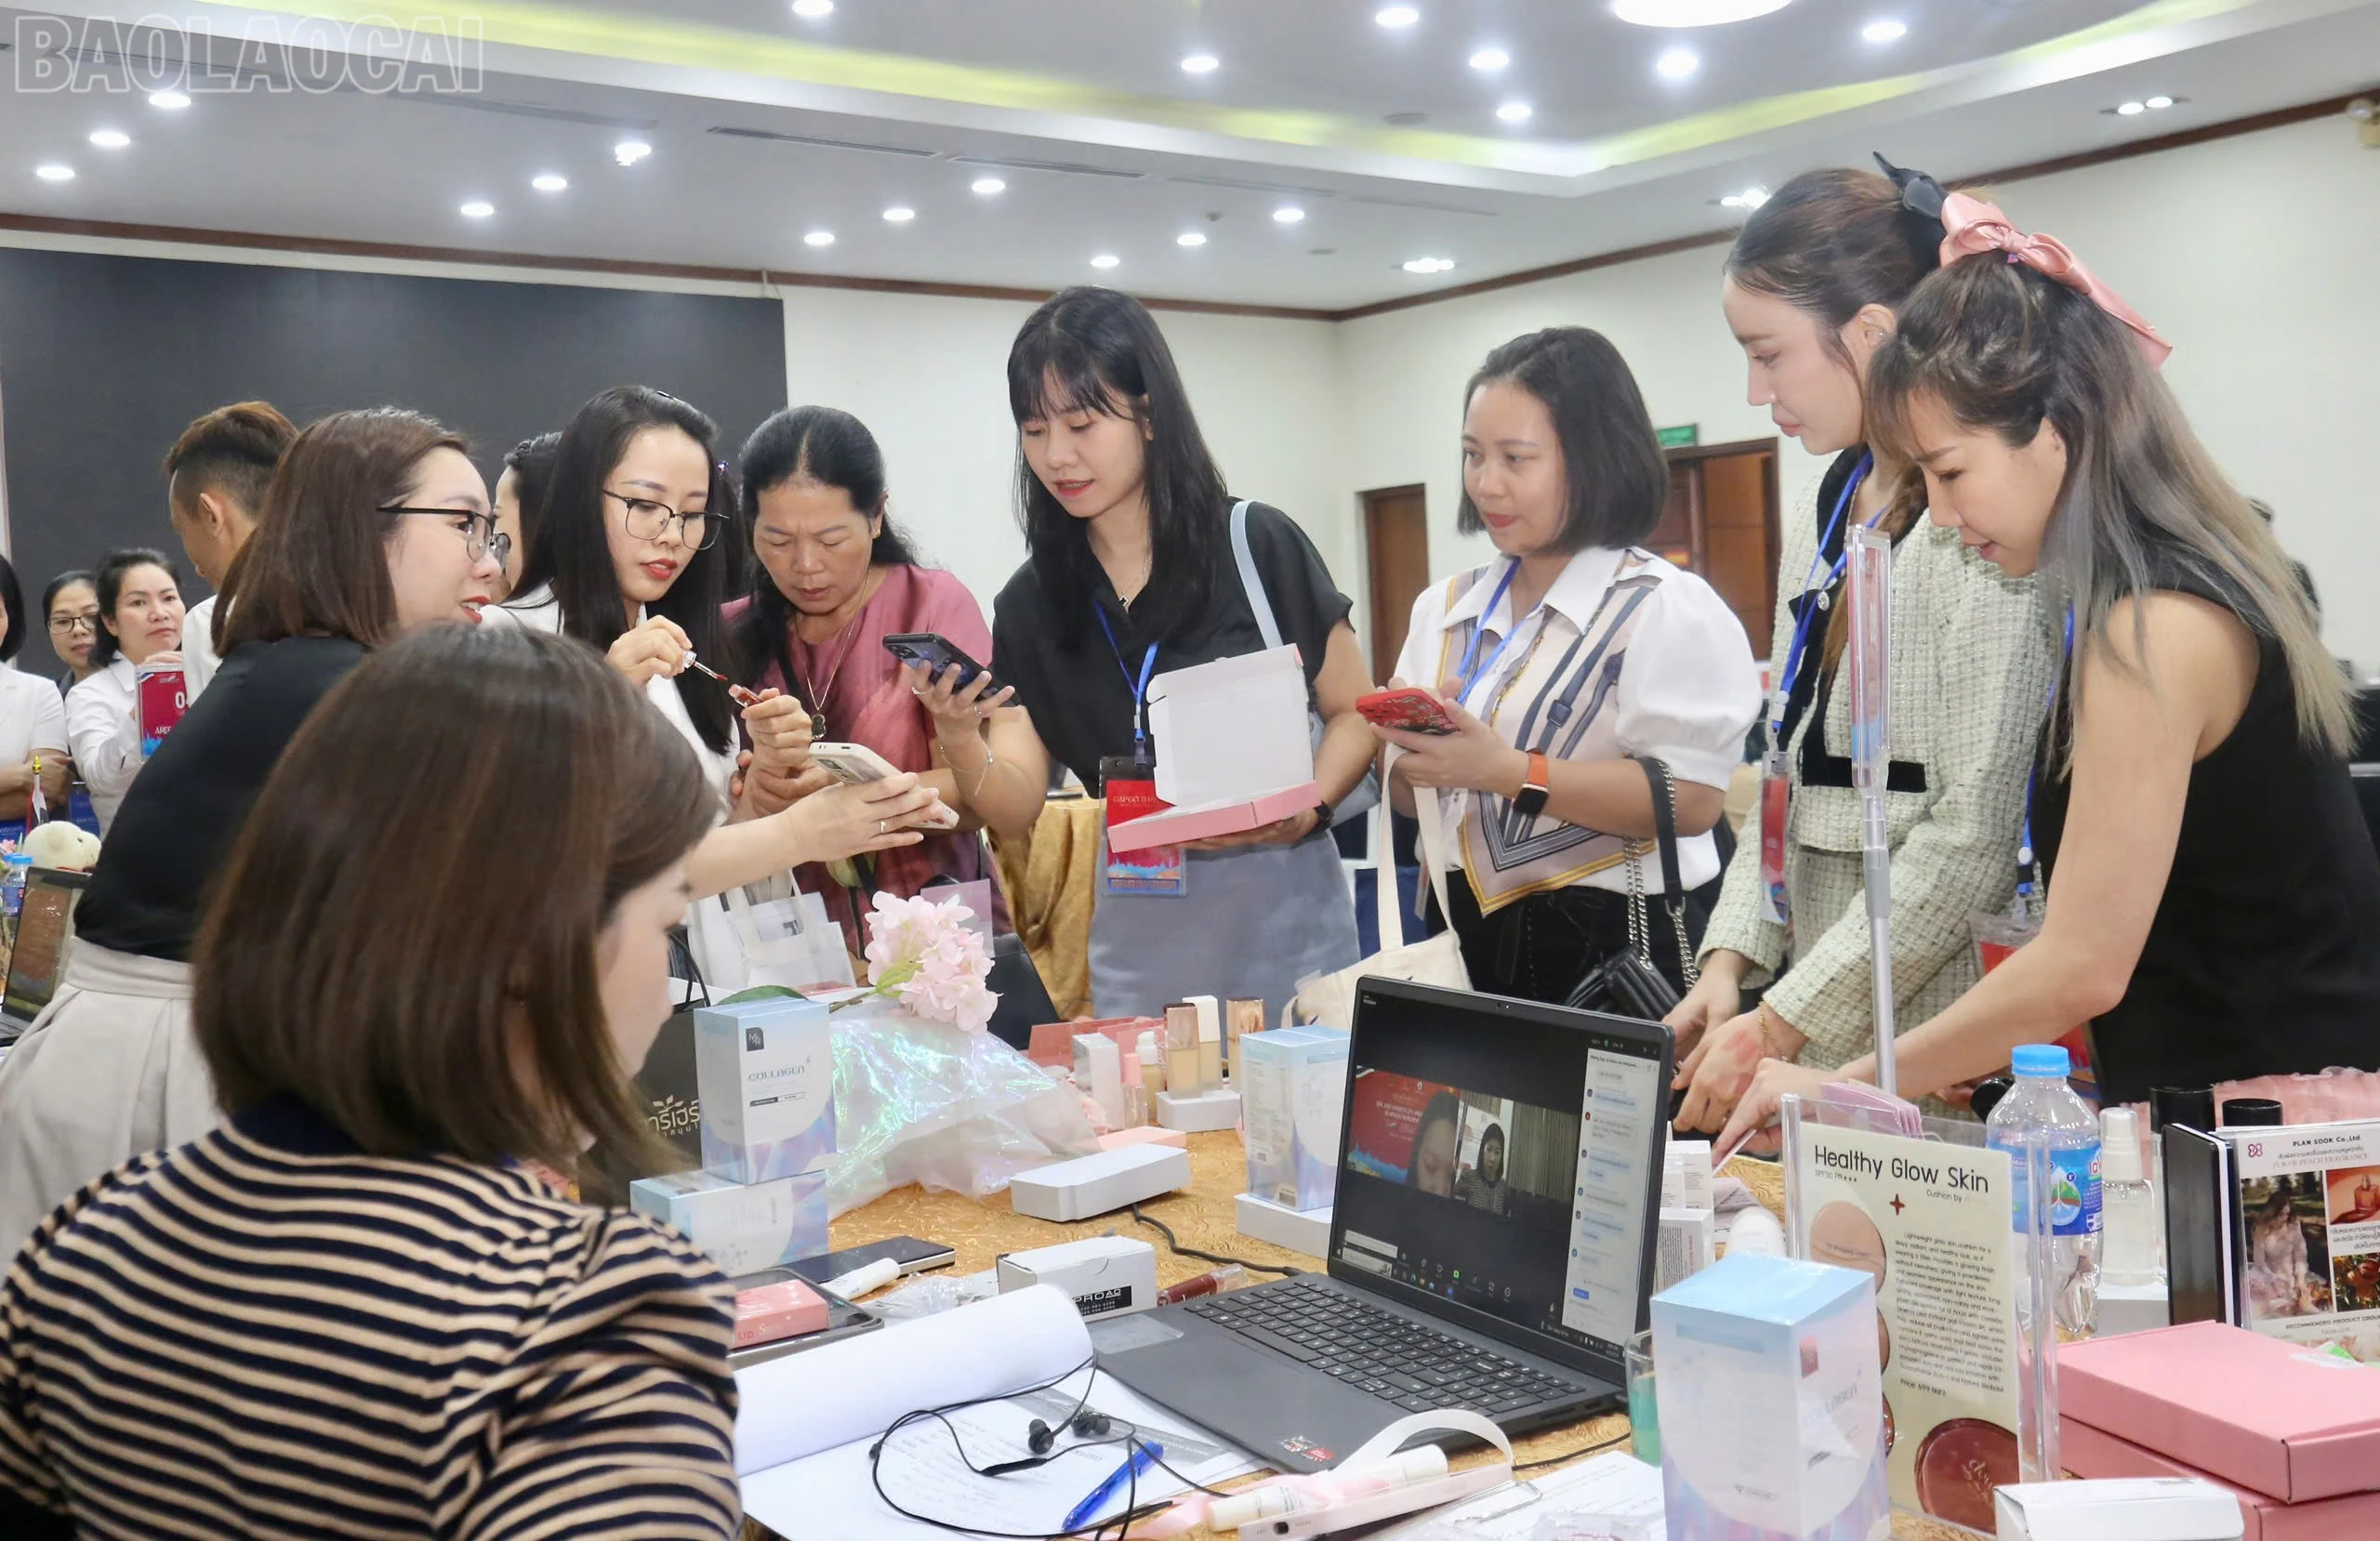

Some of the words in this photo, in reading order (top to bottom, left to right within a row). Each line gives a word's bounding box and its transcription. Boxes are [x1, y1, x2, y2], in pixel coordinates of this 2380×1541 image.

[748, 1065, 805, 1082] COLLAGEN
[1815, 1144, 1883, 1180] Healthy
[1891, 1158, 1939, 1185] Glow
[1948, 1166, 1989, 1193] Skin
[1926, 1189, 1952, 1202] Cushion
[1953, 1193, 1963, 1204] by
[1918, 1383, 1930, 1392] 699
